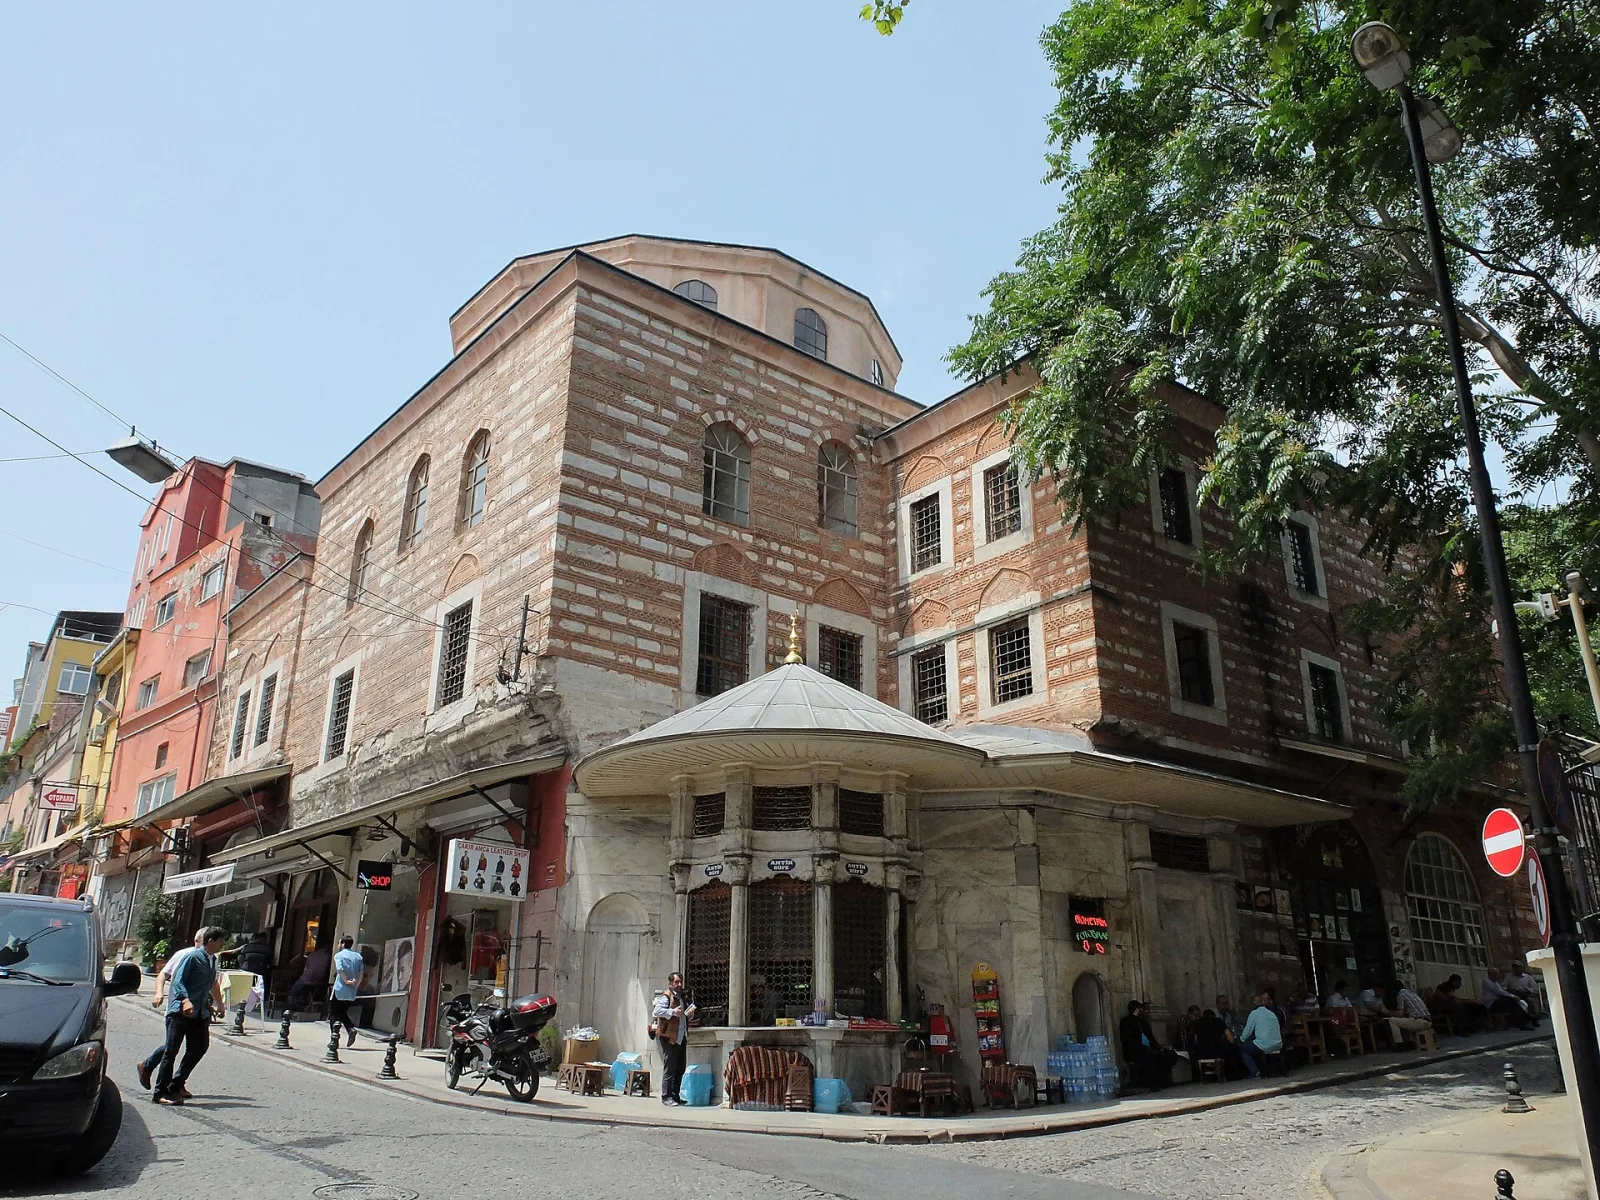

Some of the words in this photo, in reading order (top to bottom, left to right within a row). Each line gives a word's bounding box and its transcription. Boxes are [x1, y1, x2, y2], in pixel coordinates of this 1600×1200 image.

[48, 794, 75, 803] OTOPARK
[491, 848, 513, 856] LEATHER
[371, 875, 391, 886] SHOP
